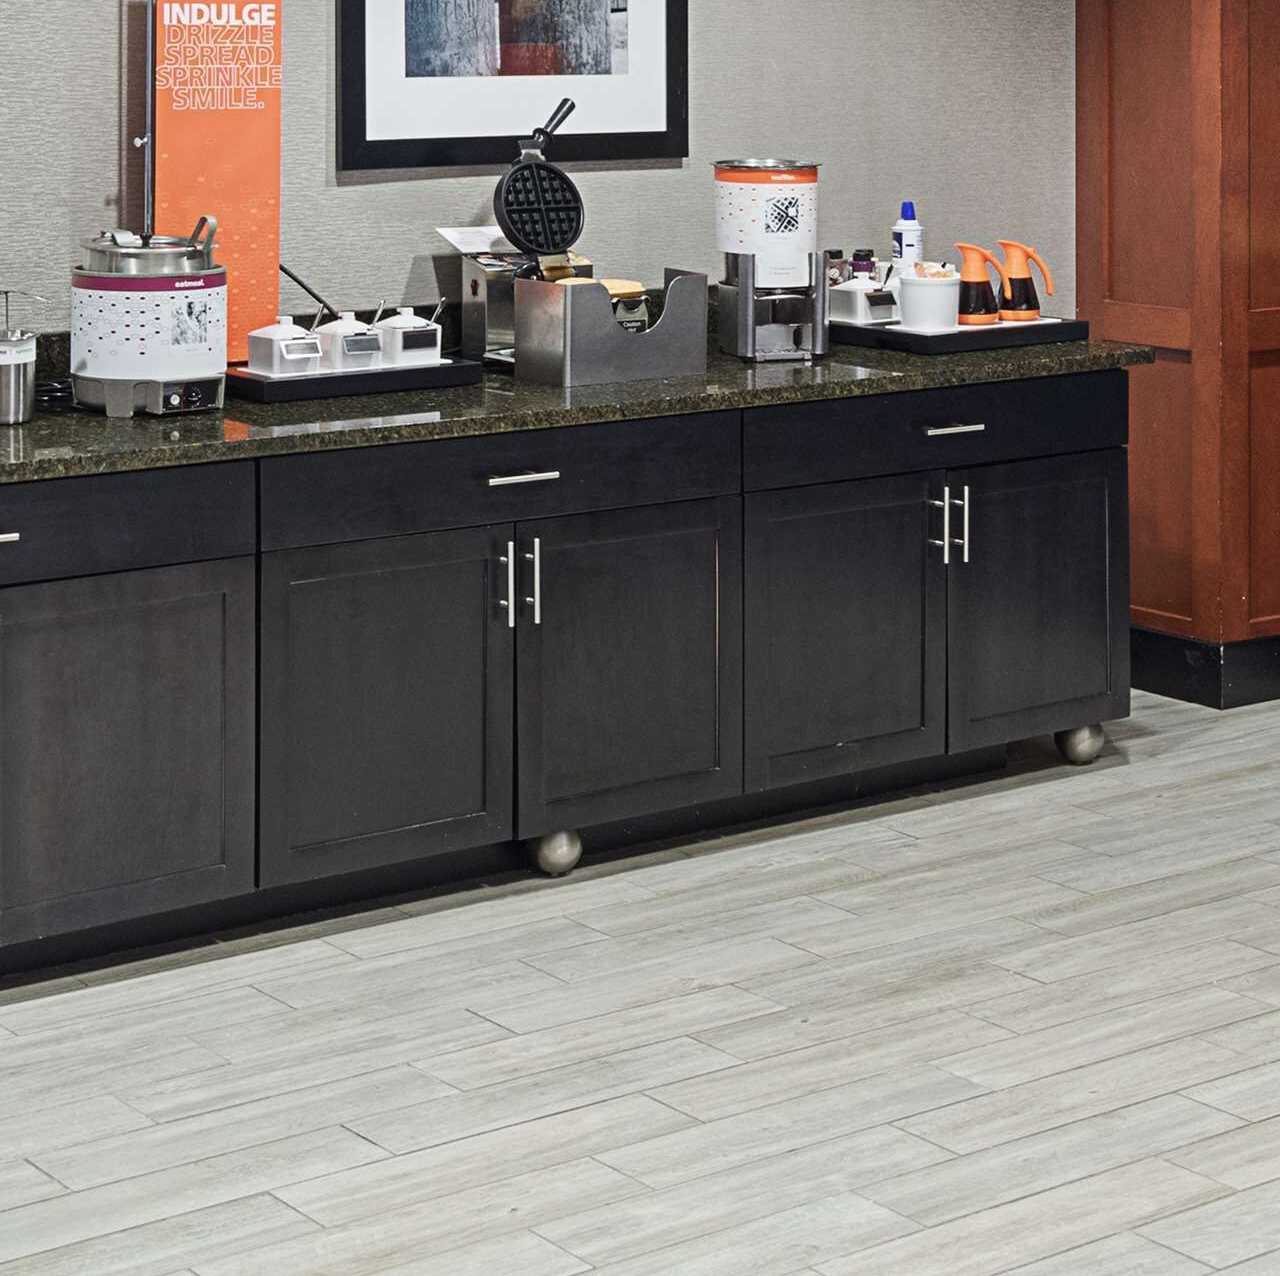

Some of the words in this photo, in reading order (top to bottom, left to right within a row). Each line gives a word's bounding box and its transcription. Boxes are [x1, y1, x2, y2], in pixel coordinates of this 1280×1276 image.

[163, 3, 276, 25] INDULGE
[166, 24, 274, 46] DRIZZLE
[164, 44, 274, 66] SPREAD
[156, 65, 282, 88] SPRINKLE
[172, 86, 265, 110] SMILE.
